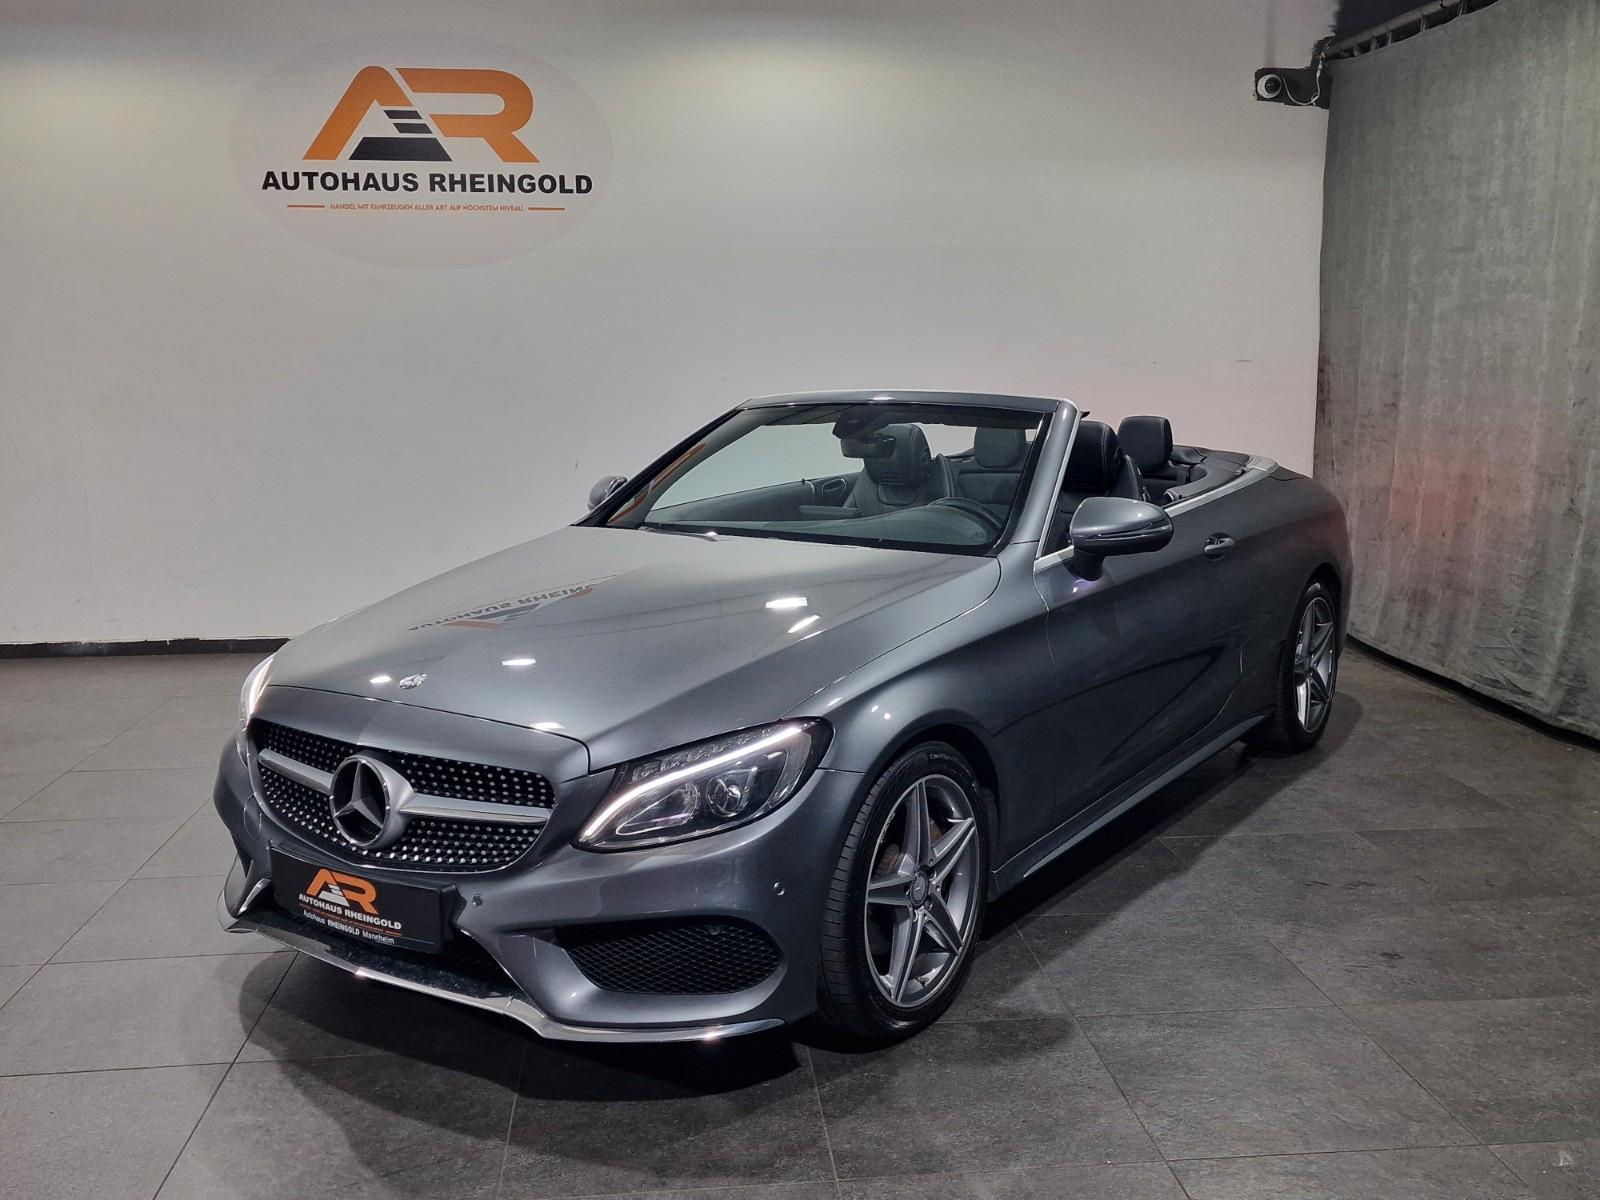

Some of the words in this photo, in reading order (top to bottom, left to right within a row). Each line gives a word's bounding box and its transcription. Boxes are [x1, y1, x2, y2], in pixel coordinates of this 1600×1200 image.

[302, 65, 540, 163] AR
[262, 171, 419, 193] AUTOHAUS
[429, 173, 593, 195] RHEINGOLD
[370, 203, 412, 211] FAHRZEUGEN
[463, 203, 498, 211] HÖCHSTEM
[306, 867, 379, 915] AR
[299, 893, 343, 915] AUTOHAUS
[344, 909, 402, 929] RHEINGOLD
[303, 910, 326, 925] Autohaus
[327, 919, 360, 936] RHEINGOLD
[362, 930, 395, 945] Mannheim
